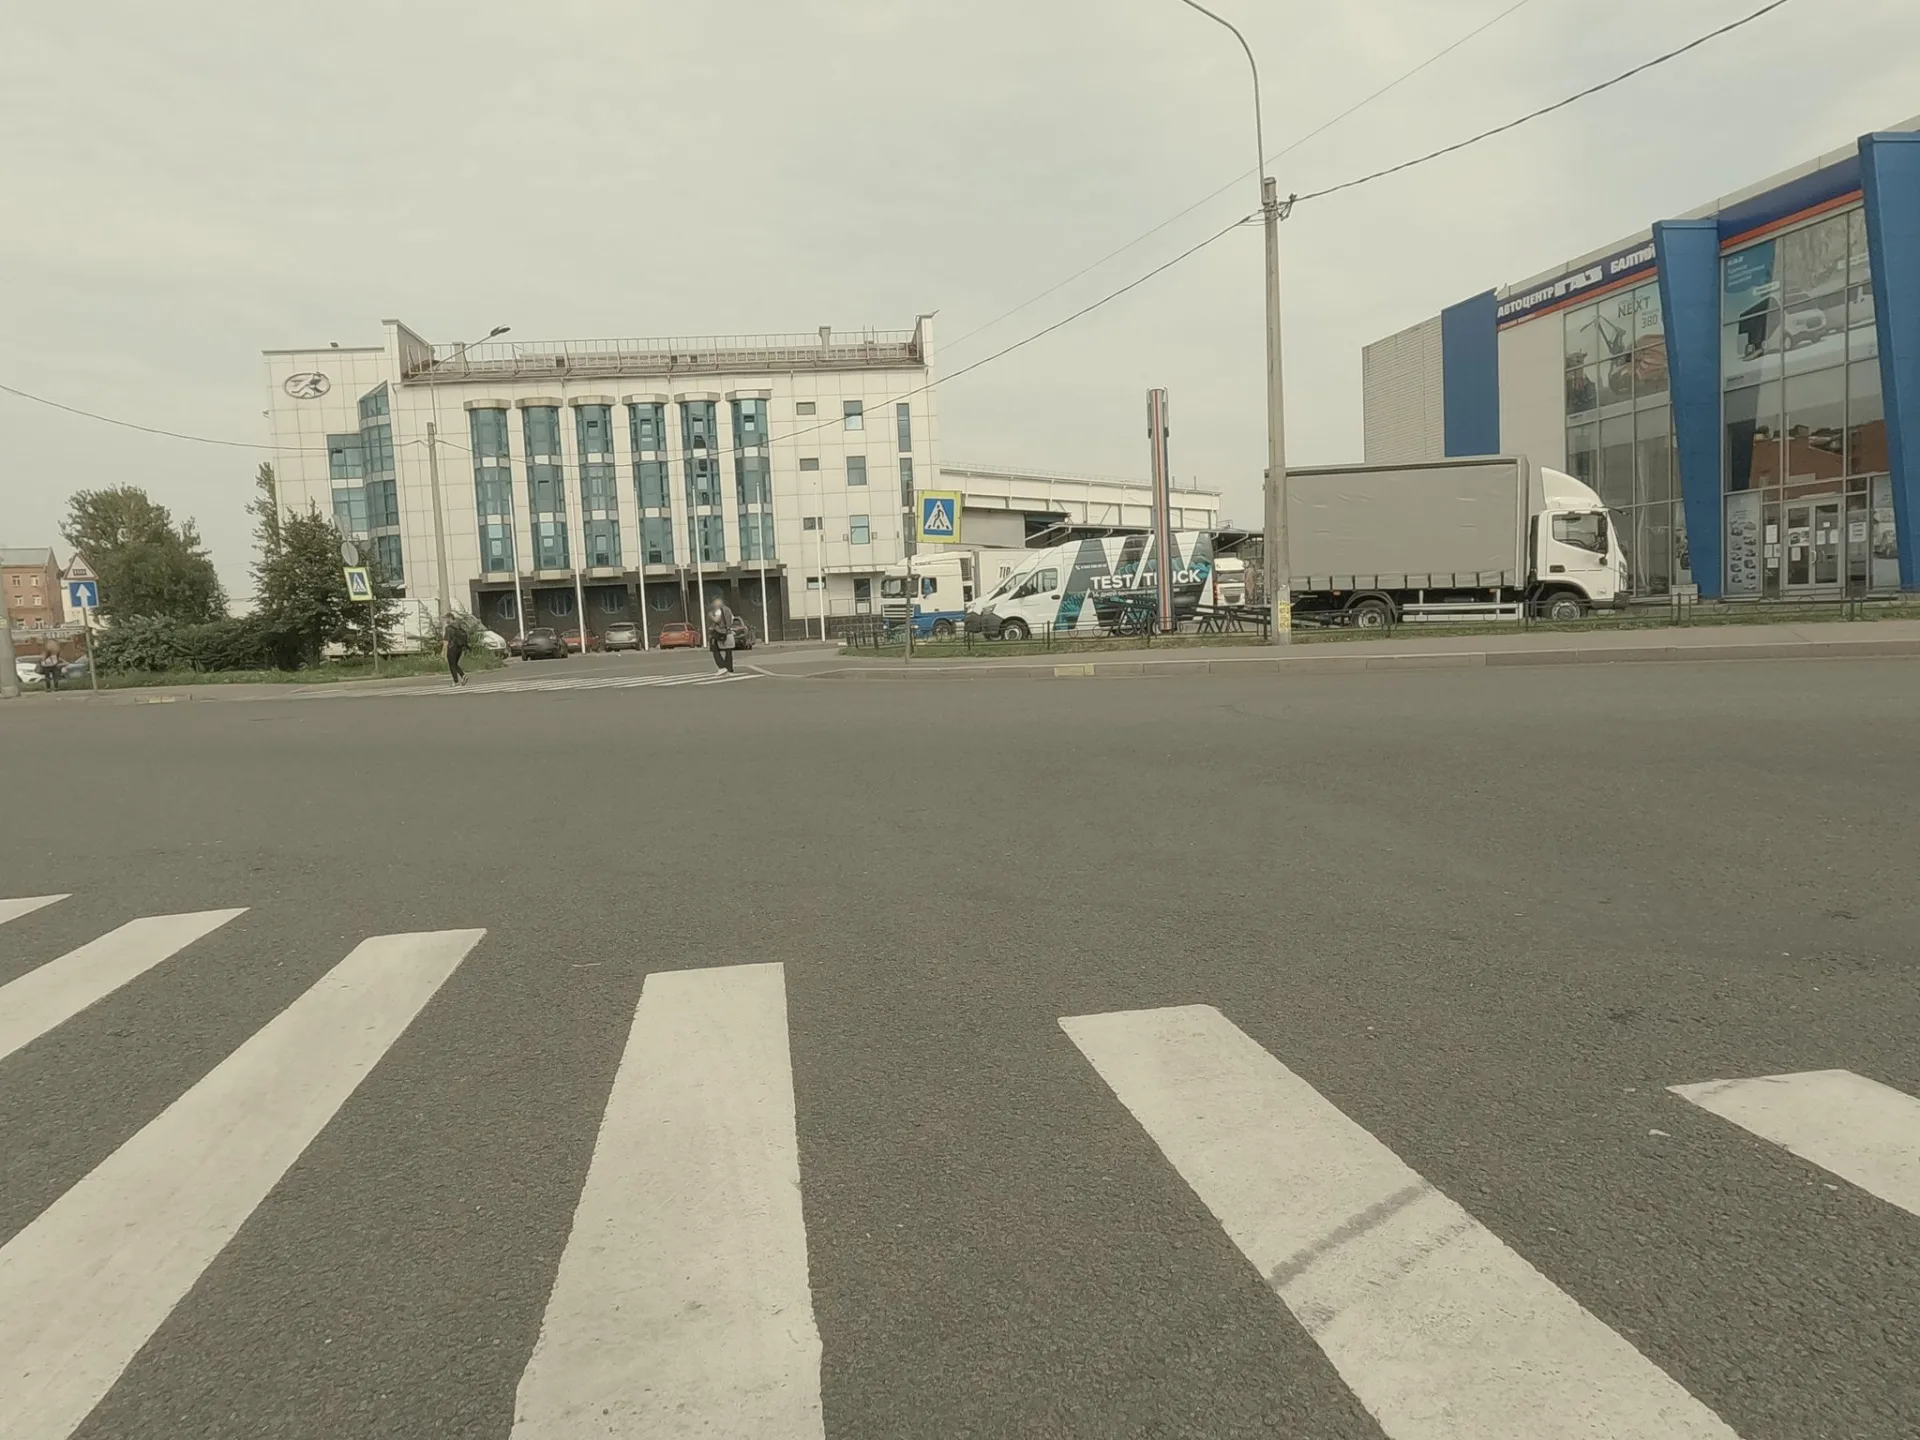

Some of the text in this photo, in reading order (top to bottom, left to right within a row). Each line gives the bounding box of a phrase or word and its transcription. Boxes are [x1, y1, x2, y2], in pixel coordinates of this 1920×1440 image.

[1497, 289, 1554, 317] АВТОЦЕНТР
[1617, 296, 1651, 319] NEXT
[1090, 574, 1133, 590] TEST
